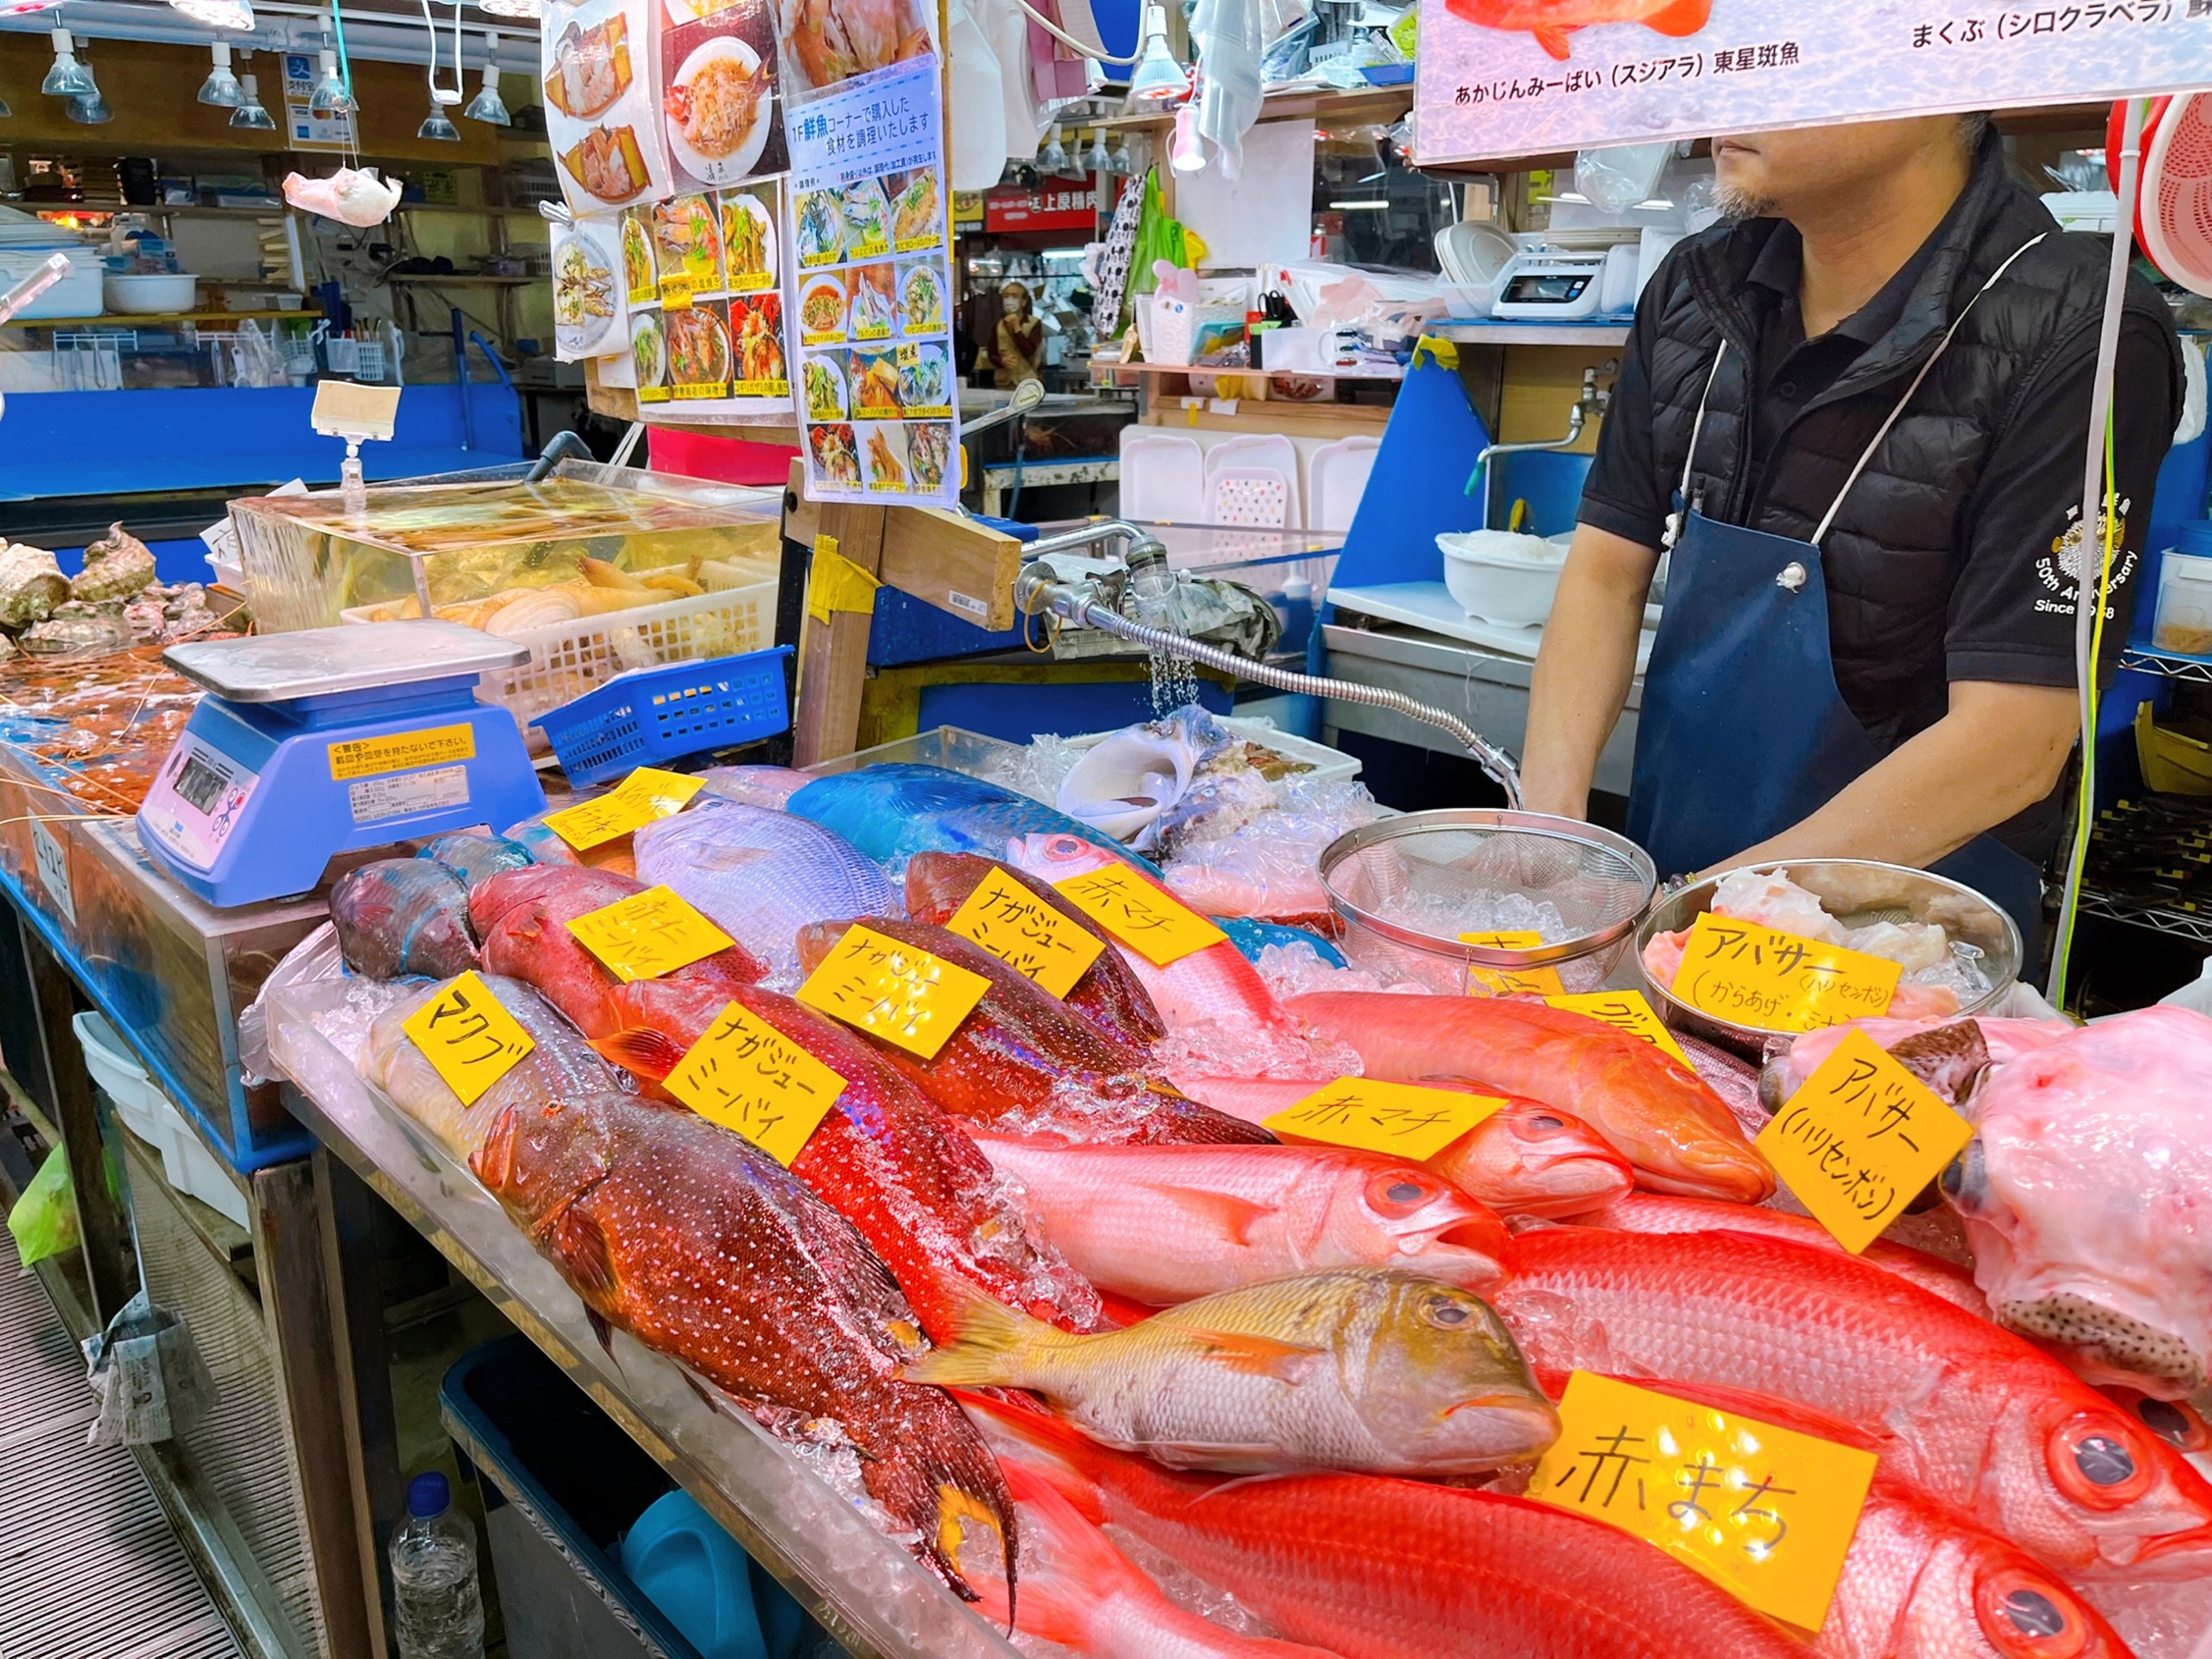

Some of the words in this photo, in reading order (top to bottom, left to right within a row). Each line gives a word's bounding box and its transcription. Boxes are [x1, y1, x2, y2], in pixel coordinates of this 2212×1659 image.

[792, 95, 909, 143] 1F鮮魚コーナーで購入した
[827, 112, 929, 156] 食材を調理いたします
[2035, 558, 2060, 591] 50th
[2034, 600, 2075, 615] Since
[979, 886, 1077, 954] ナガジュー
[1066, 877, 1177, 935] 赤マチ
[583, 916, 664, 968] ミーバイ
[843, 938, 942, 988] ナガジュー
[971, 925, 1047, 980] ミーバイ
[1705, 927, 1847, 977] アバサー
[428, 990, 524, 1065] マクブ
[832, 976, 932, 1032] ミーバイ
[713, 1016, 817, 1096] ナガジュー
[687, 1058, 784, 1140] ミーバイ
[1296, 1095, 1454, 1137] 赤マチ
[1829, 1057, 1919, 1153] アバサー
[1780, 1107, 1896, 1220] (ハリセンボン)
[1555, 1424, 1797, 1554] 赤まち
